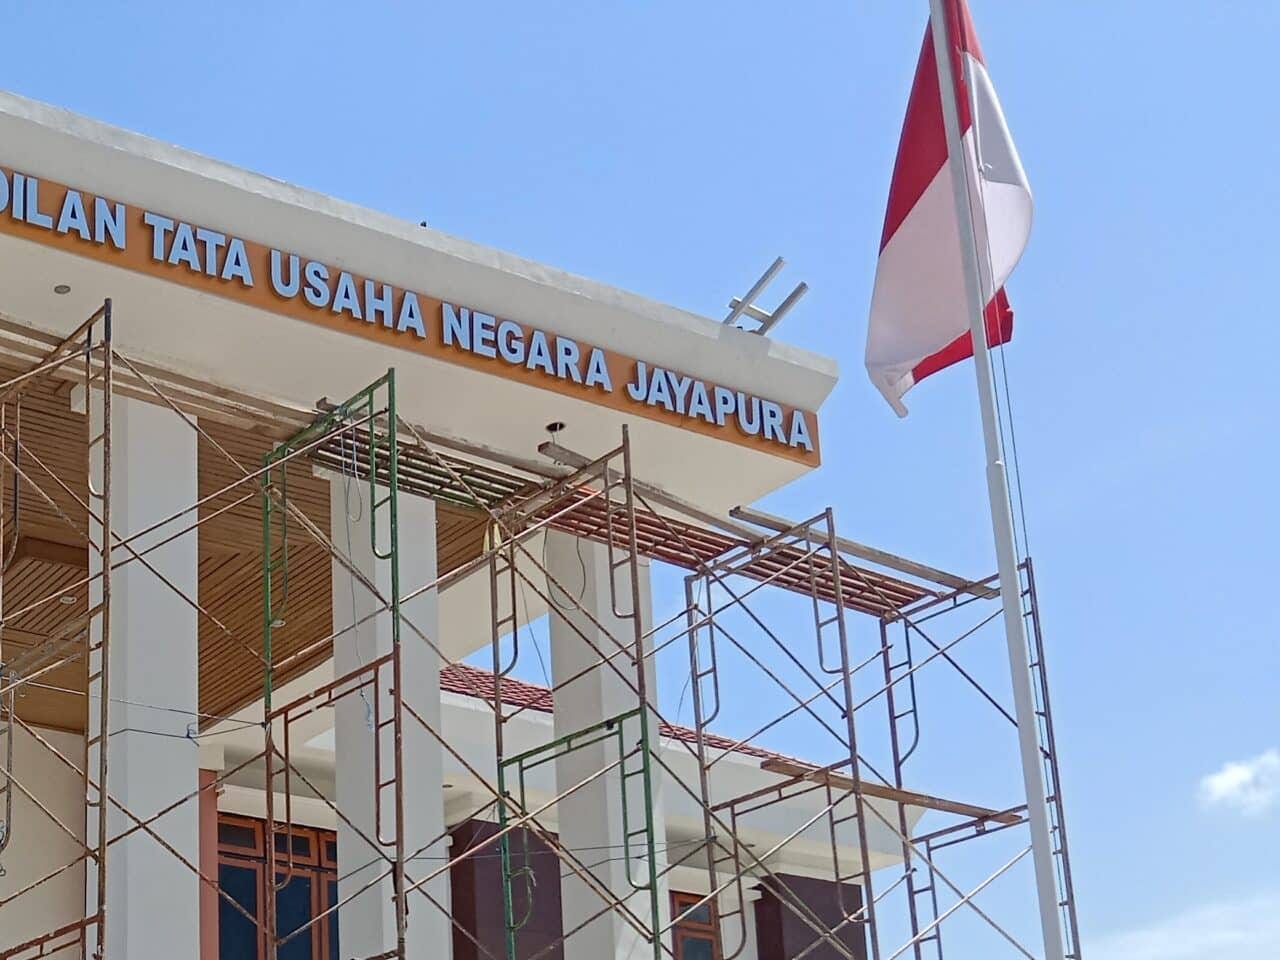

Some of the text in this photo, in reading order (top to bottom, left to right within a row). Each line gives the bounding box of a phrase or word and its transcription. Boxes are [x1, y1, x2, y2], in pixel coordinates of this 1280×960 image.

[144, 211, 253, 287] TATA
[271, 249, 426, 338] USAHA
[442, 302, 612, 392] NEGARA
[628, 360, 814, 452] JAYAPURA
